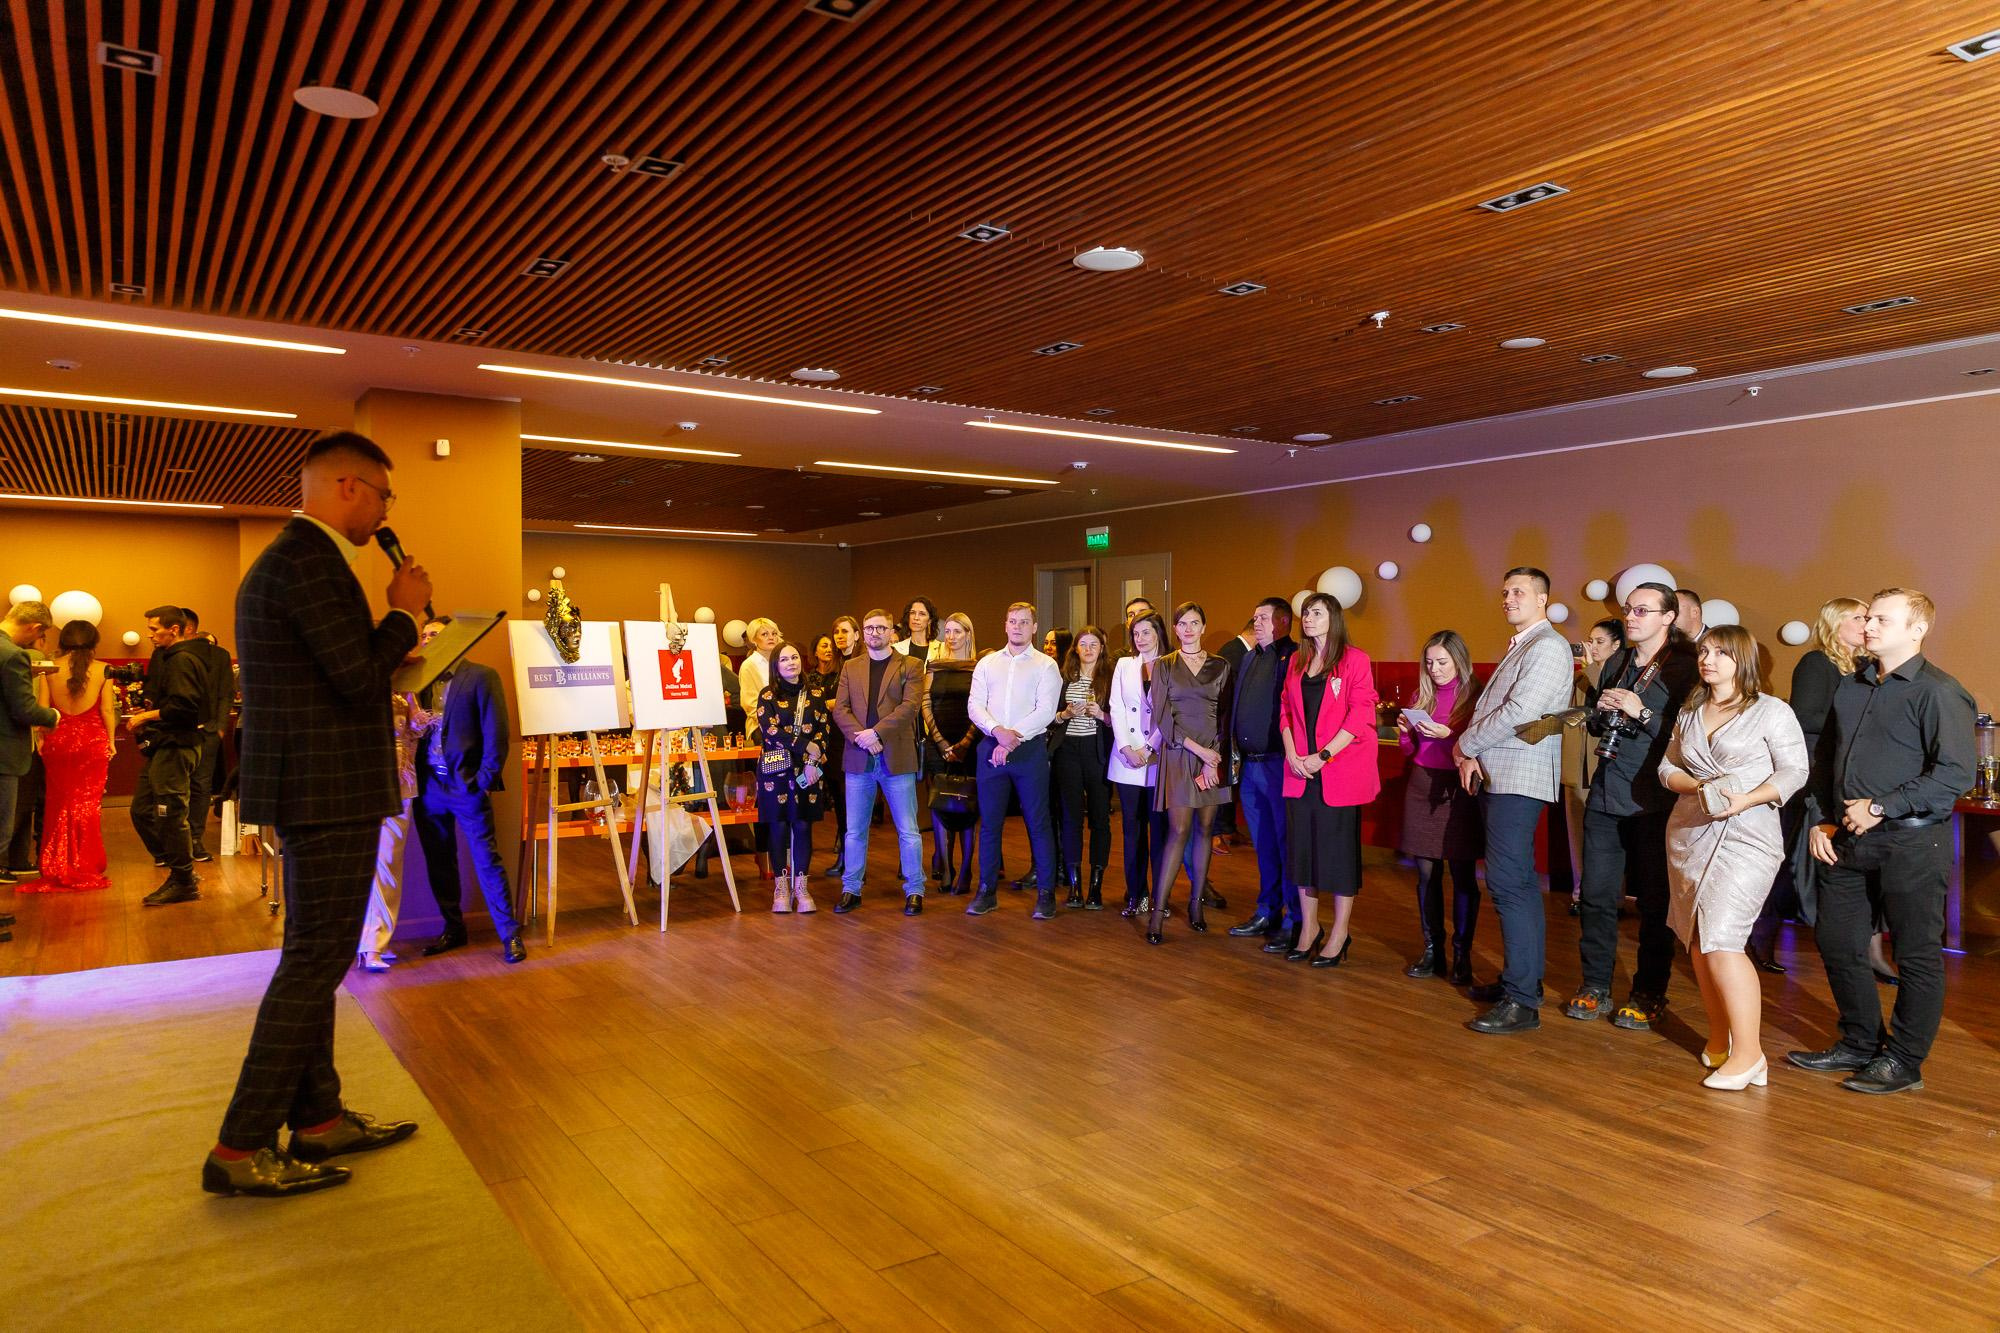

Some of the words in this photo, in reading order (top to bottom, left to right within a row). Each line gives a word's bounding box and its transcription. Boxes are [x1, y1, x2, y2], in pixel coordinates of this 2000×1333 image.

[534, 673, 553, 682] BEST
[567, 672, 610, 681] BRILLIANTS
[764, 754, 785, 765] KARL
